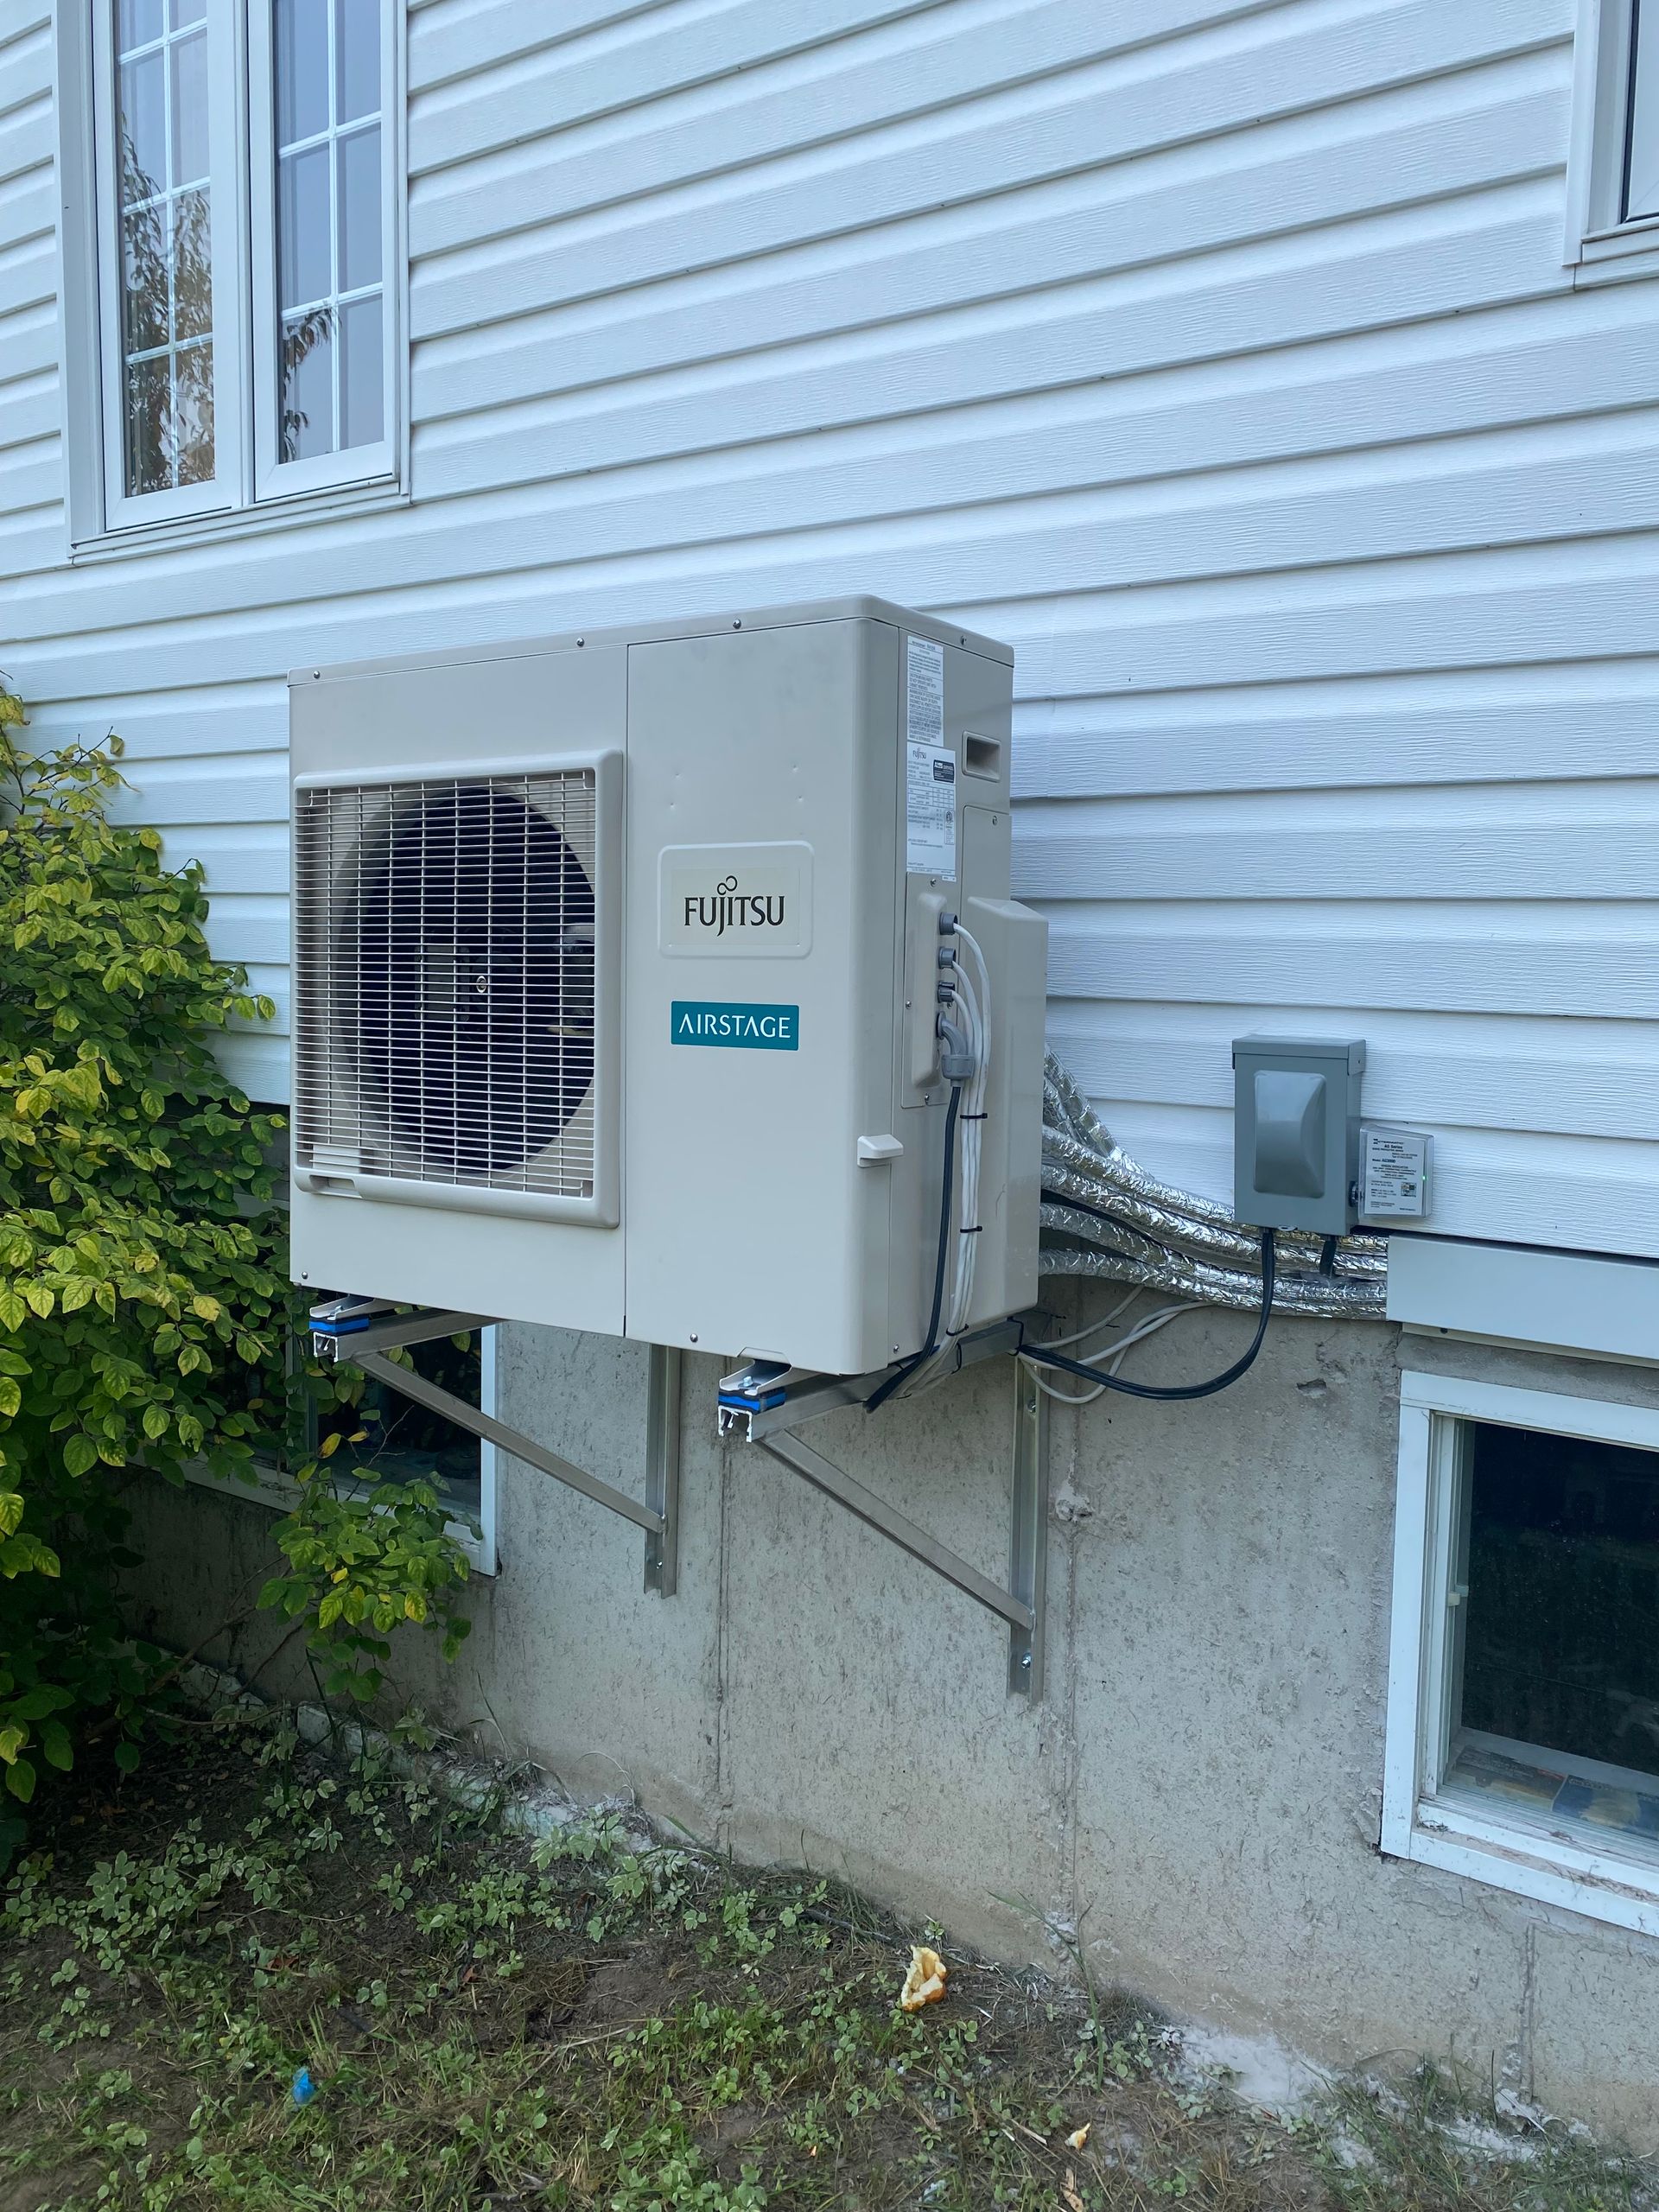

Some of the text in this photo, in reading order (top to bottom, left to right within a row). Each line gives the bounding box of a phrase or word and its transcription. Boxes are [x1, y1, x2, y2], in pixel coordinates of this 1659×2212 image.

[912, 749, 926, 760] FUJITSU
[683, 895, 785, 937] FUJITSU
[678, 1013, 791, 1039] AIRSTAGE
